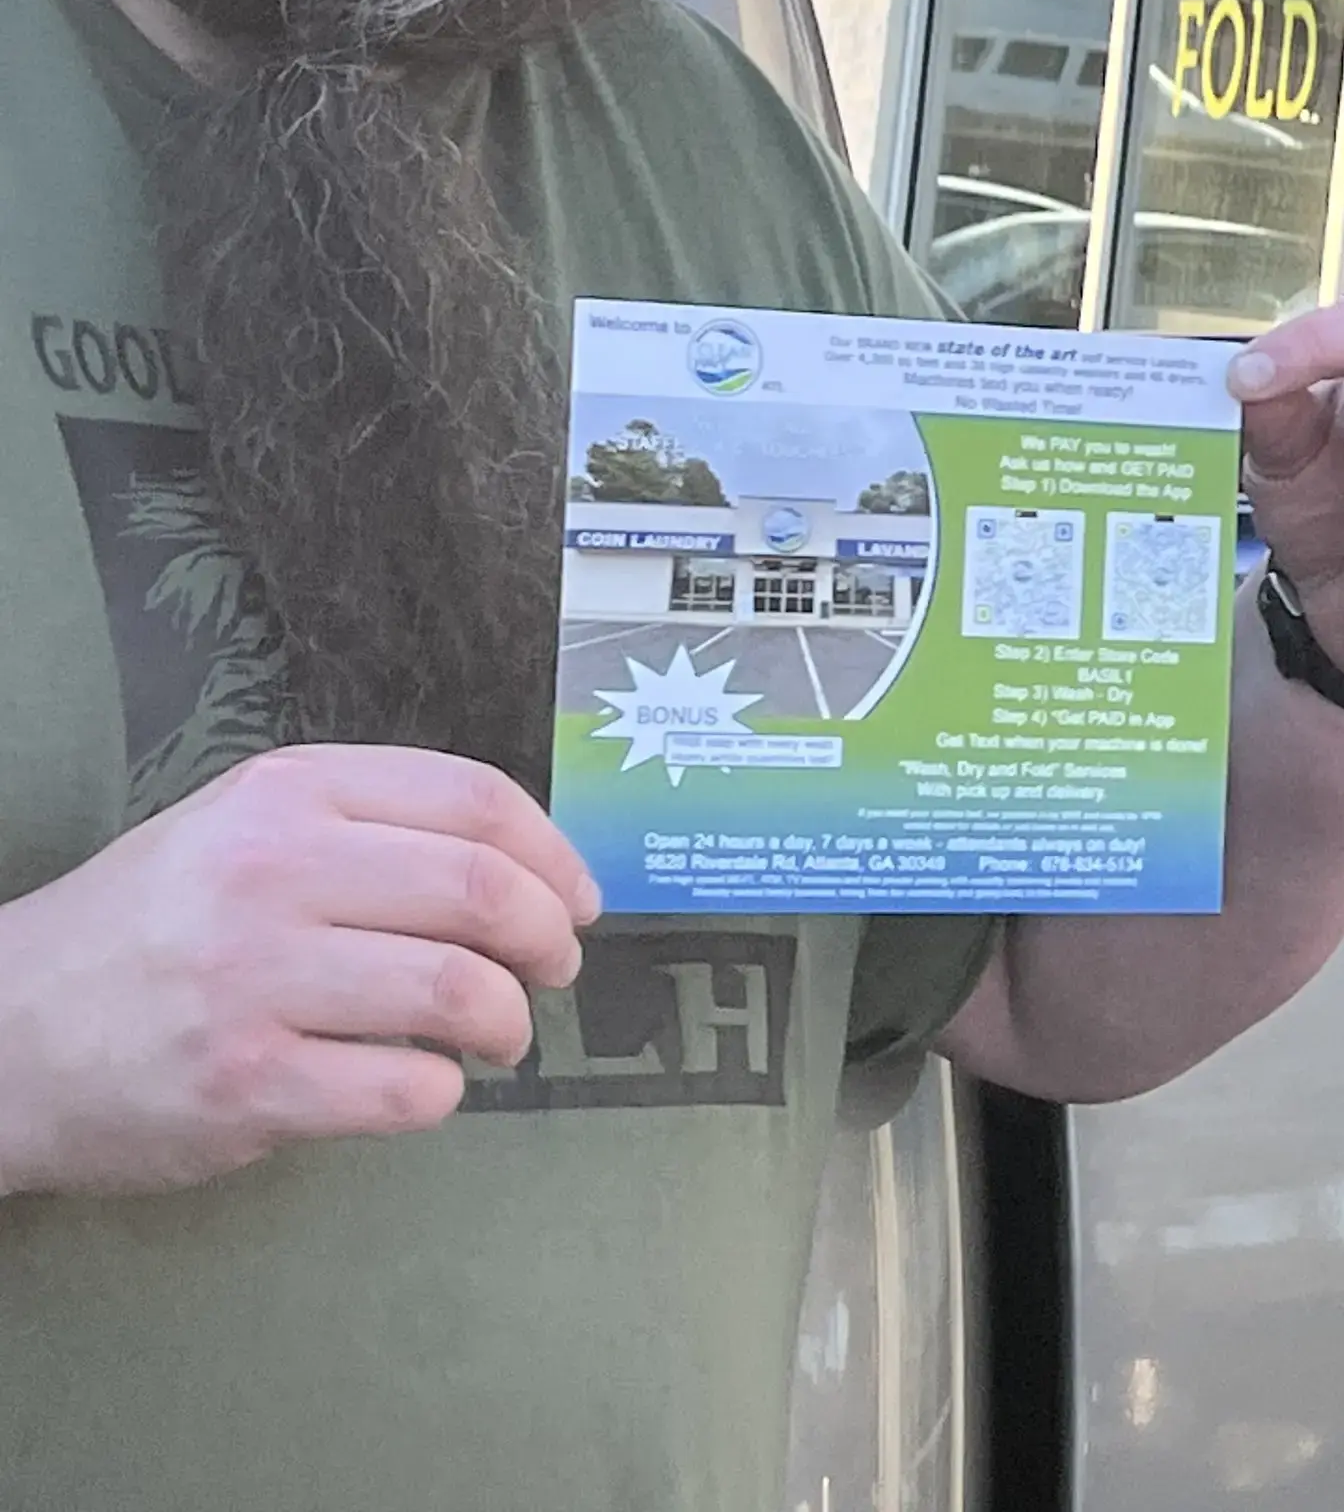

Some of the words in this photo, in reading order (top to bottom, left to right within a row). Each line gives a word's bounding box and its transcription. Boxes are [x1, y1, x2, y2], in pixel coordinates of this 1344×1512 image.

[589, 315, 668, 334] Welcome
[675, 321, 691, 335] to
[937, 342, 985, 356] state
[991, 342, 1011, 357] of
[1015, 345, 1045, 360] the
[1051, 349, 1077, 361] art
[1050, 437, 1082, 452] PAY
[1085, 442, 1112, 457] you
[1000, 455, 1029, 470] Ask
[1053, 458, 1085, 472] how
[1089, 461, 1118, 475] and
[1120, 461, 1154, 476] GET
[1157, 463, 1195, 479] PAID
[1001, 475, 1036, 494] Step
[1041, 479, 1057, 496] 1)
[1059, 478, 1133, 497] Download
[1162, 485, 1193, 503] App
[576, 531, 625, 548] COIN
[630, 534, 722, 551] LAUNDRY
[994, 643, 1031, 662] Step
[1034, 645, 1050, 664] 2)
[1054, 646, 1094, 662] Enter
[1140, 648, 1180, 665] Code
[993, 684, 1028, 702] Step
[1033, 685, 1049, 703] 3)
[1052, 686, 1094, 701] Wash
[1107, 687, 1133, 705] Dry
[637, 705, 719, 726] BONUS
[992, 708, 1028, 727] Step
[1031, 710, 1048, 727] 4)
[1089, 711, 1125, 726] PAID
[1144, 712, 1176, 729] App
[935, 732, 965, 749] Get
[1005, 735, 1043, 750] when
[1048, 737, 1082, 753] your
[957, 761, 986, 779] Dry
[988, 763, 1018, 778] and
[1064, 764, 1127, 779] Services
[956, 784, 986, 800] pick
[991, 786, 1010, 801] up
[1014, 785, 1043, 799] and
[644, 832, 690, 851] Open
[693, 834, 714, 849] 24
[719, 834, 764, 850] hours
[769, 837, 780, 850] a
[821, 834, 831, 849] 7
[835, 834, 873, 853] days
[877, 837, 889, 850] a
[892, 838, 932, 851] week
[1031, 838, 1083, 854] always
[1086, 840, 1106, 852] on
[691, 854, 768, 871] Riverdale
[868, 856, 894, 871] GA
